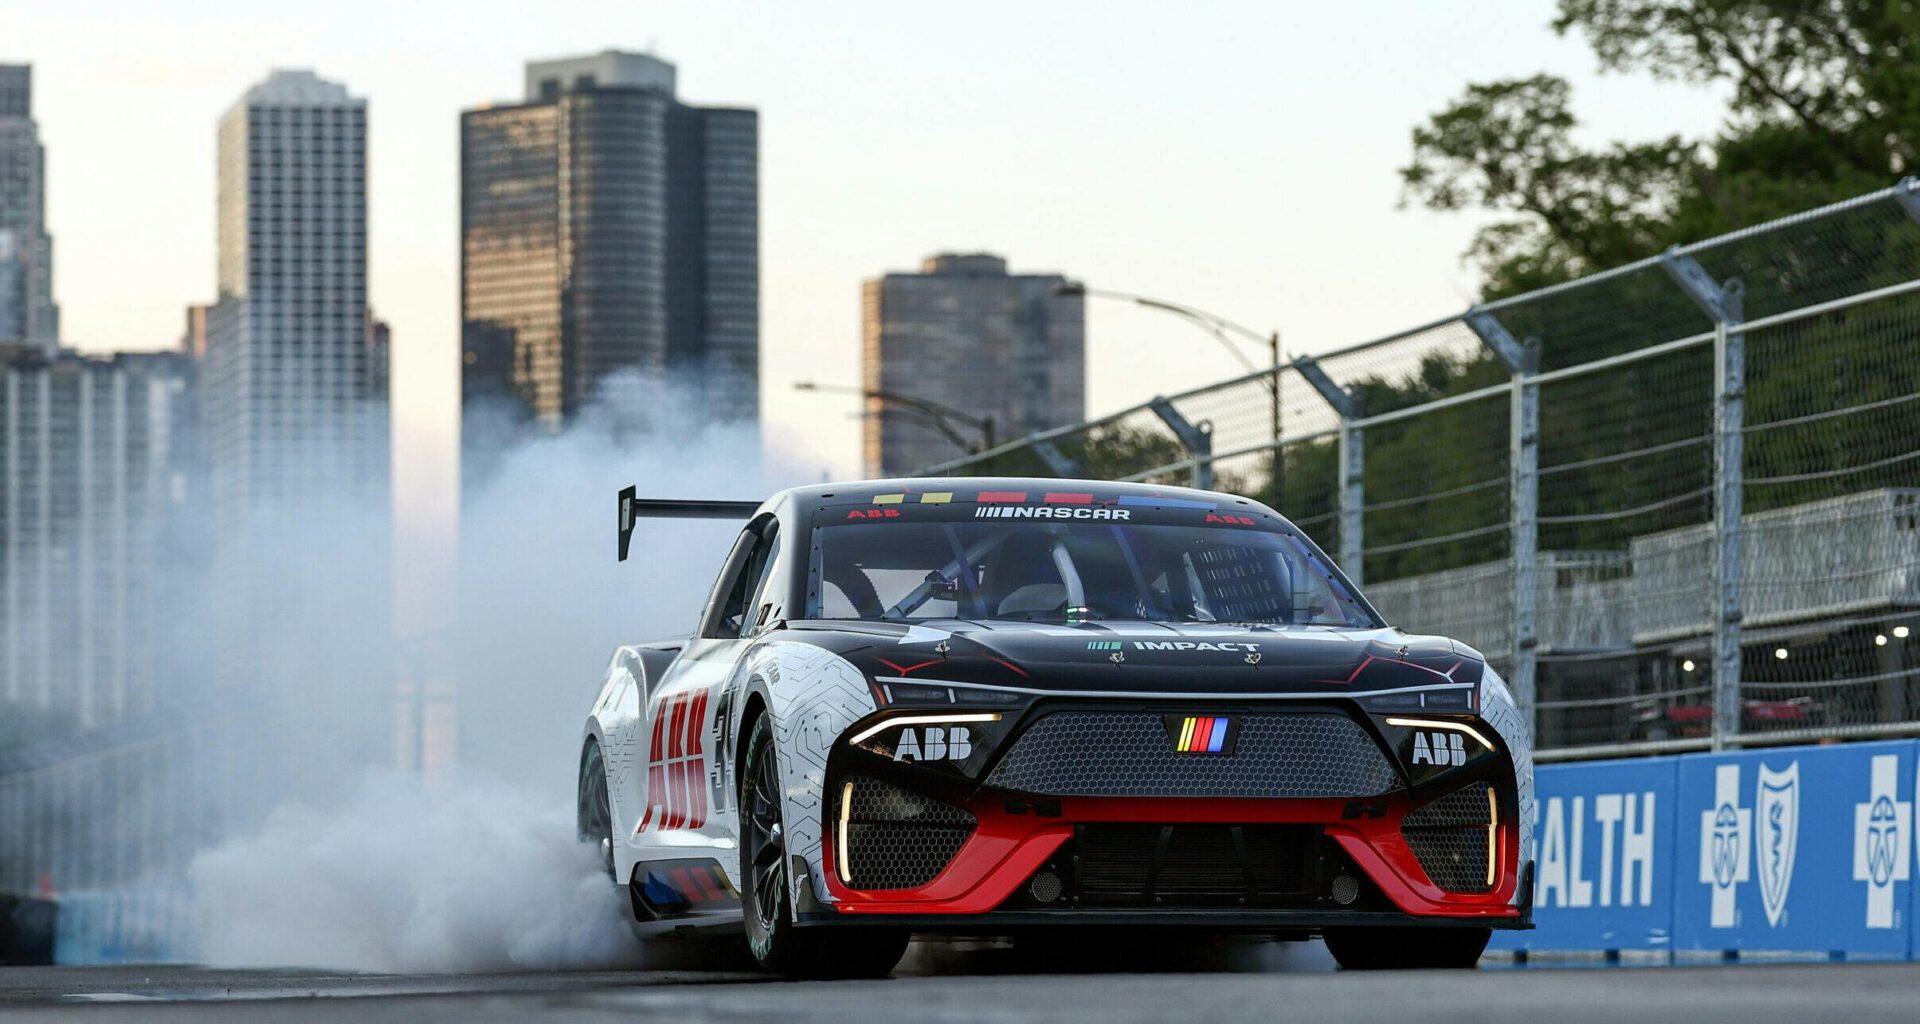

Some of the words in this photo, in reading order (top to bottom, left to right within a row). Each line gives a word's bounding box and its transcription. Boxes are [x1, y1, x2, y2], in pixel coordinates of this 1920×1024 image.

[847, 507, 901, 519] ABB
[1013, 507, 1131, 520] NASCAR
[1205, 513, 1256, 526] ABB
[1133, 641, 1261, 653] IMPACT
[893, 726, 972, 763] ABB
[1412, 731, 1467, 768] ABB
[637, 687, 709, 834] ABB
